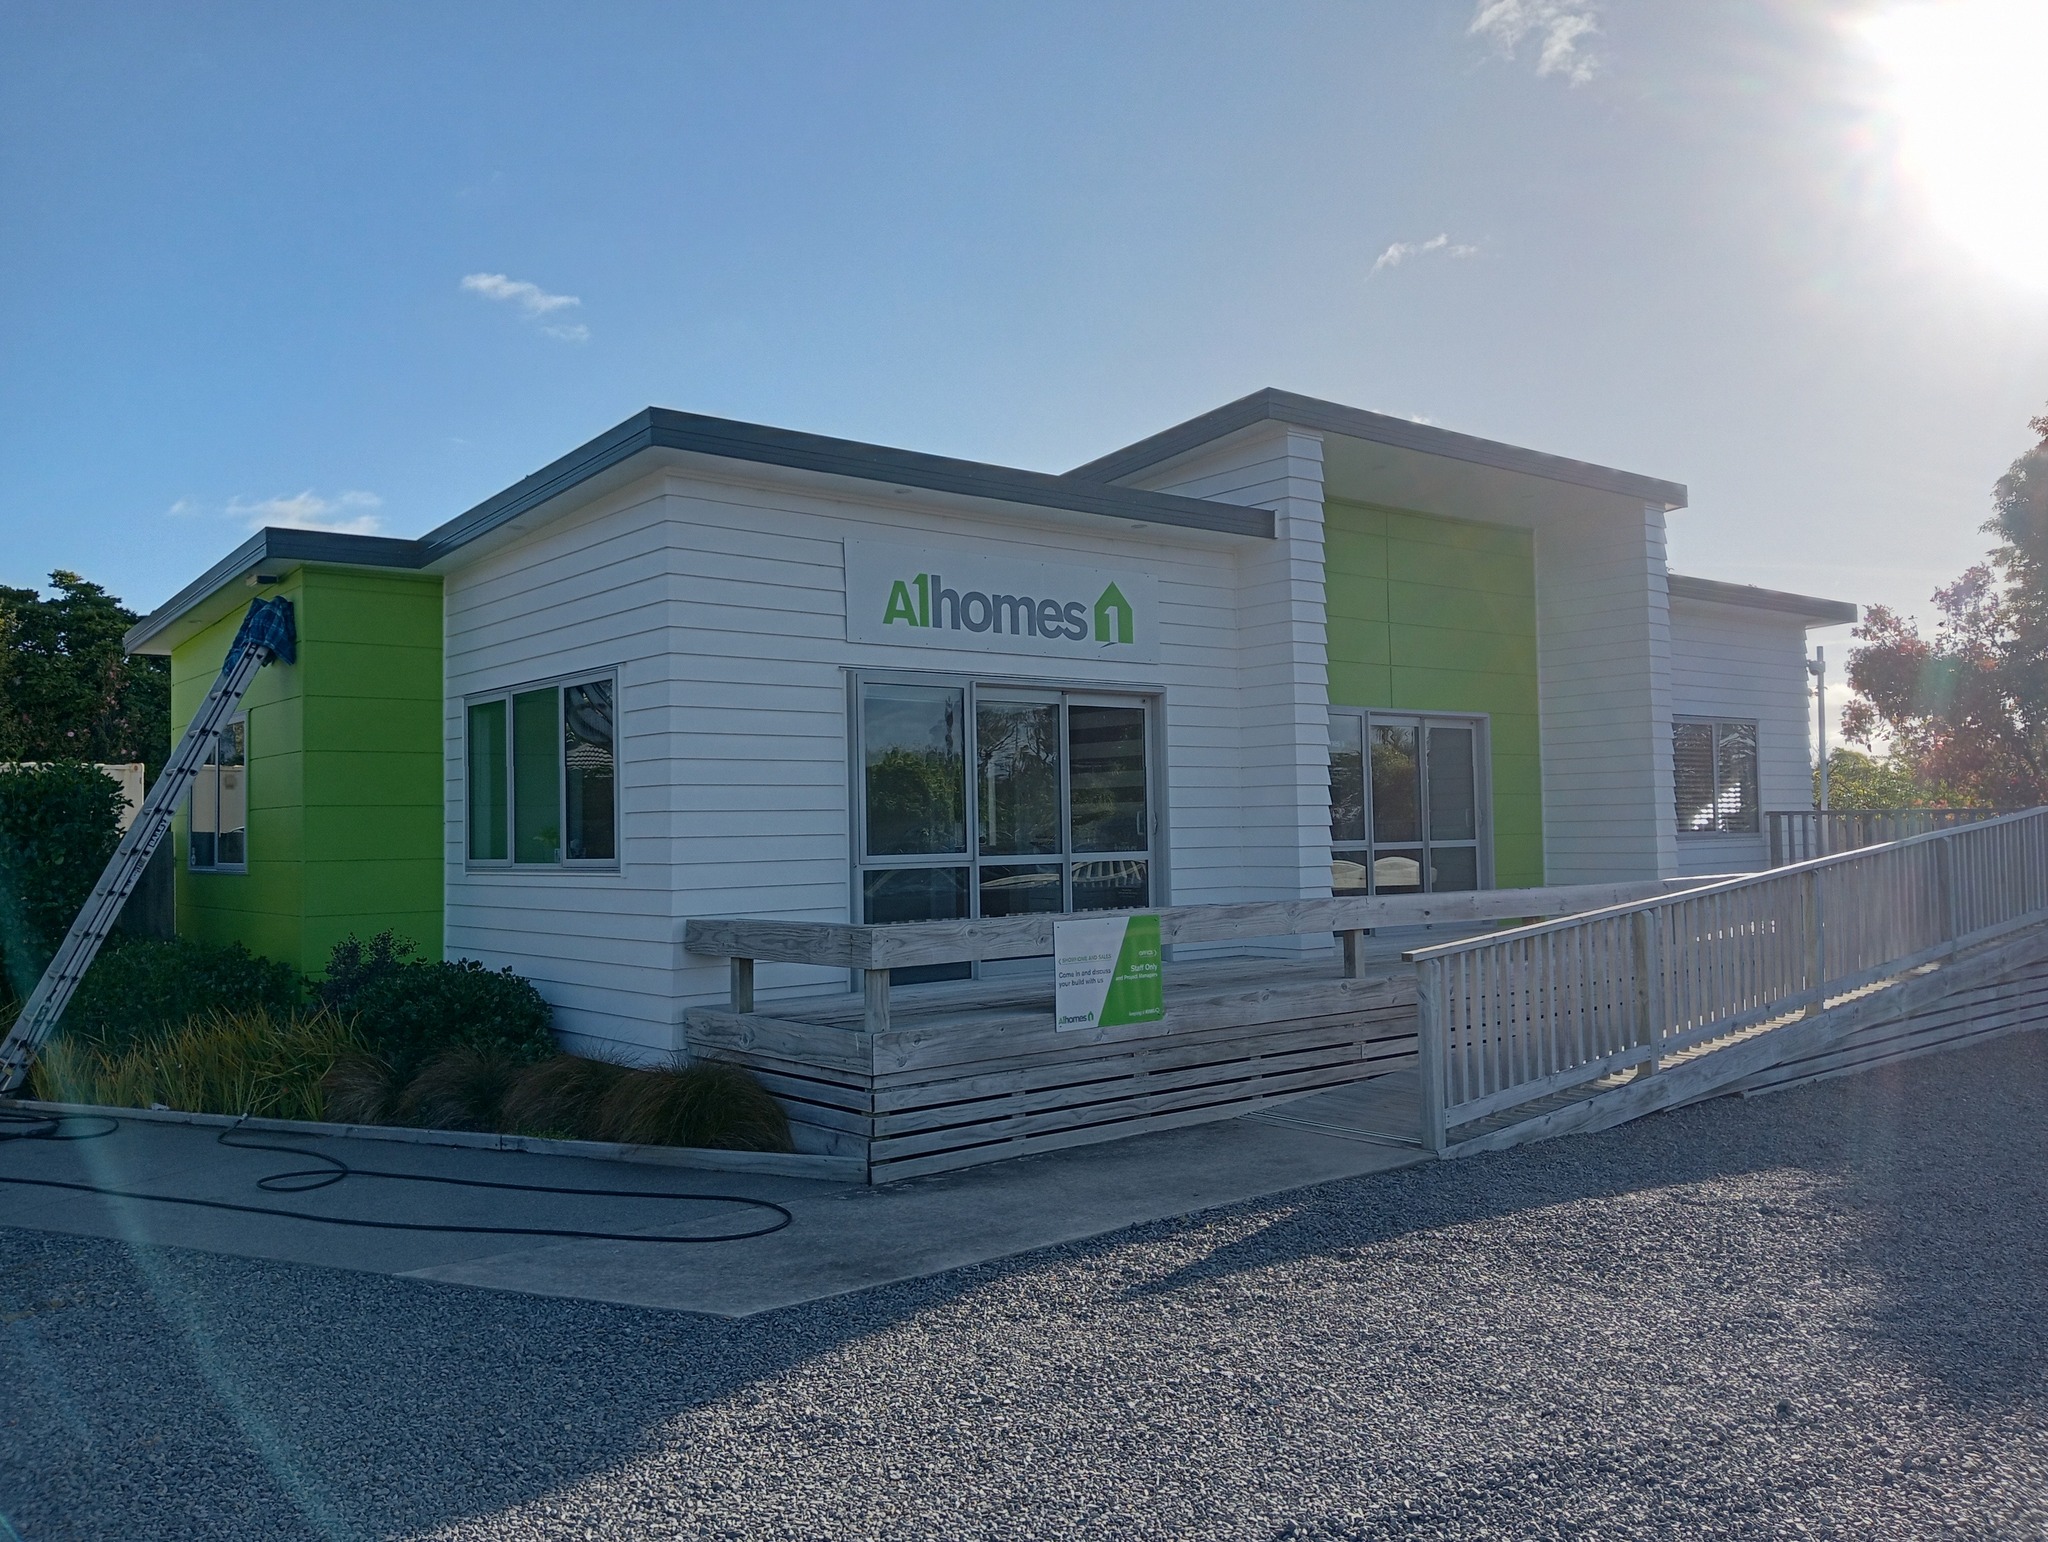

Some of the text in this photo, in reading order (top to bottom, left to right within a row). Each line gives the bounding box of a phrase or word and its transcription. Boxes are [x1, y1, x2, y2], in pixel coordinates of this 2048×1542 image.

[1130, 963, 1158, 972] Staff Only
[1075, 969, 1081, 977] in
[1059, 981, 1071, 989] your
